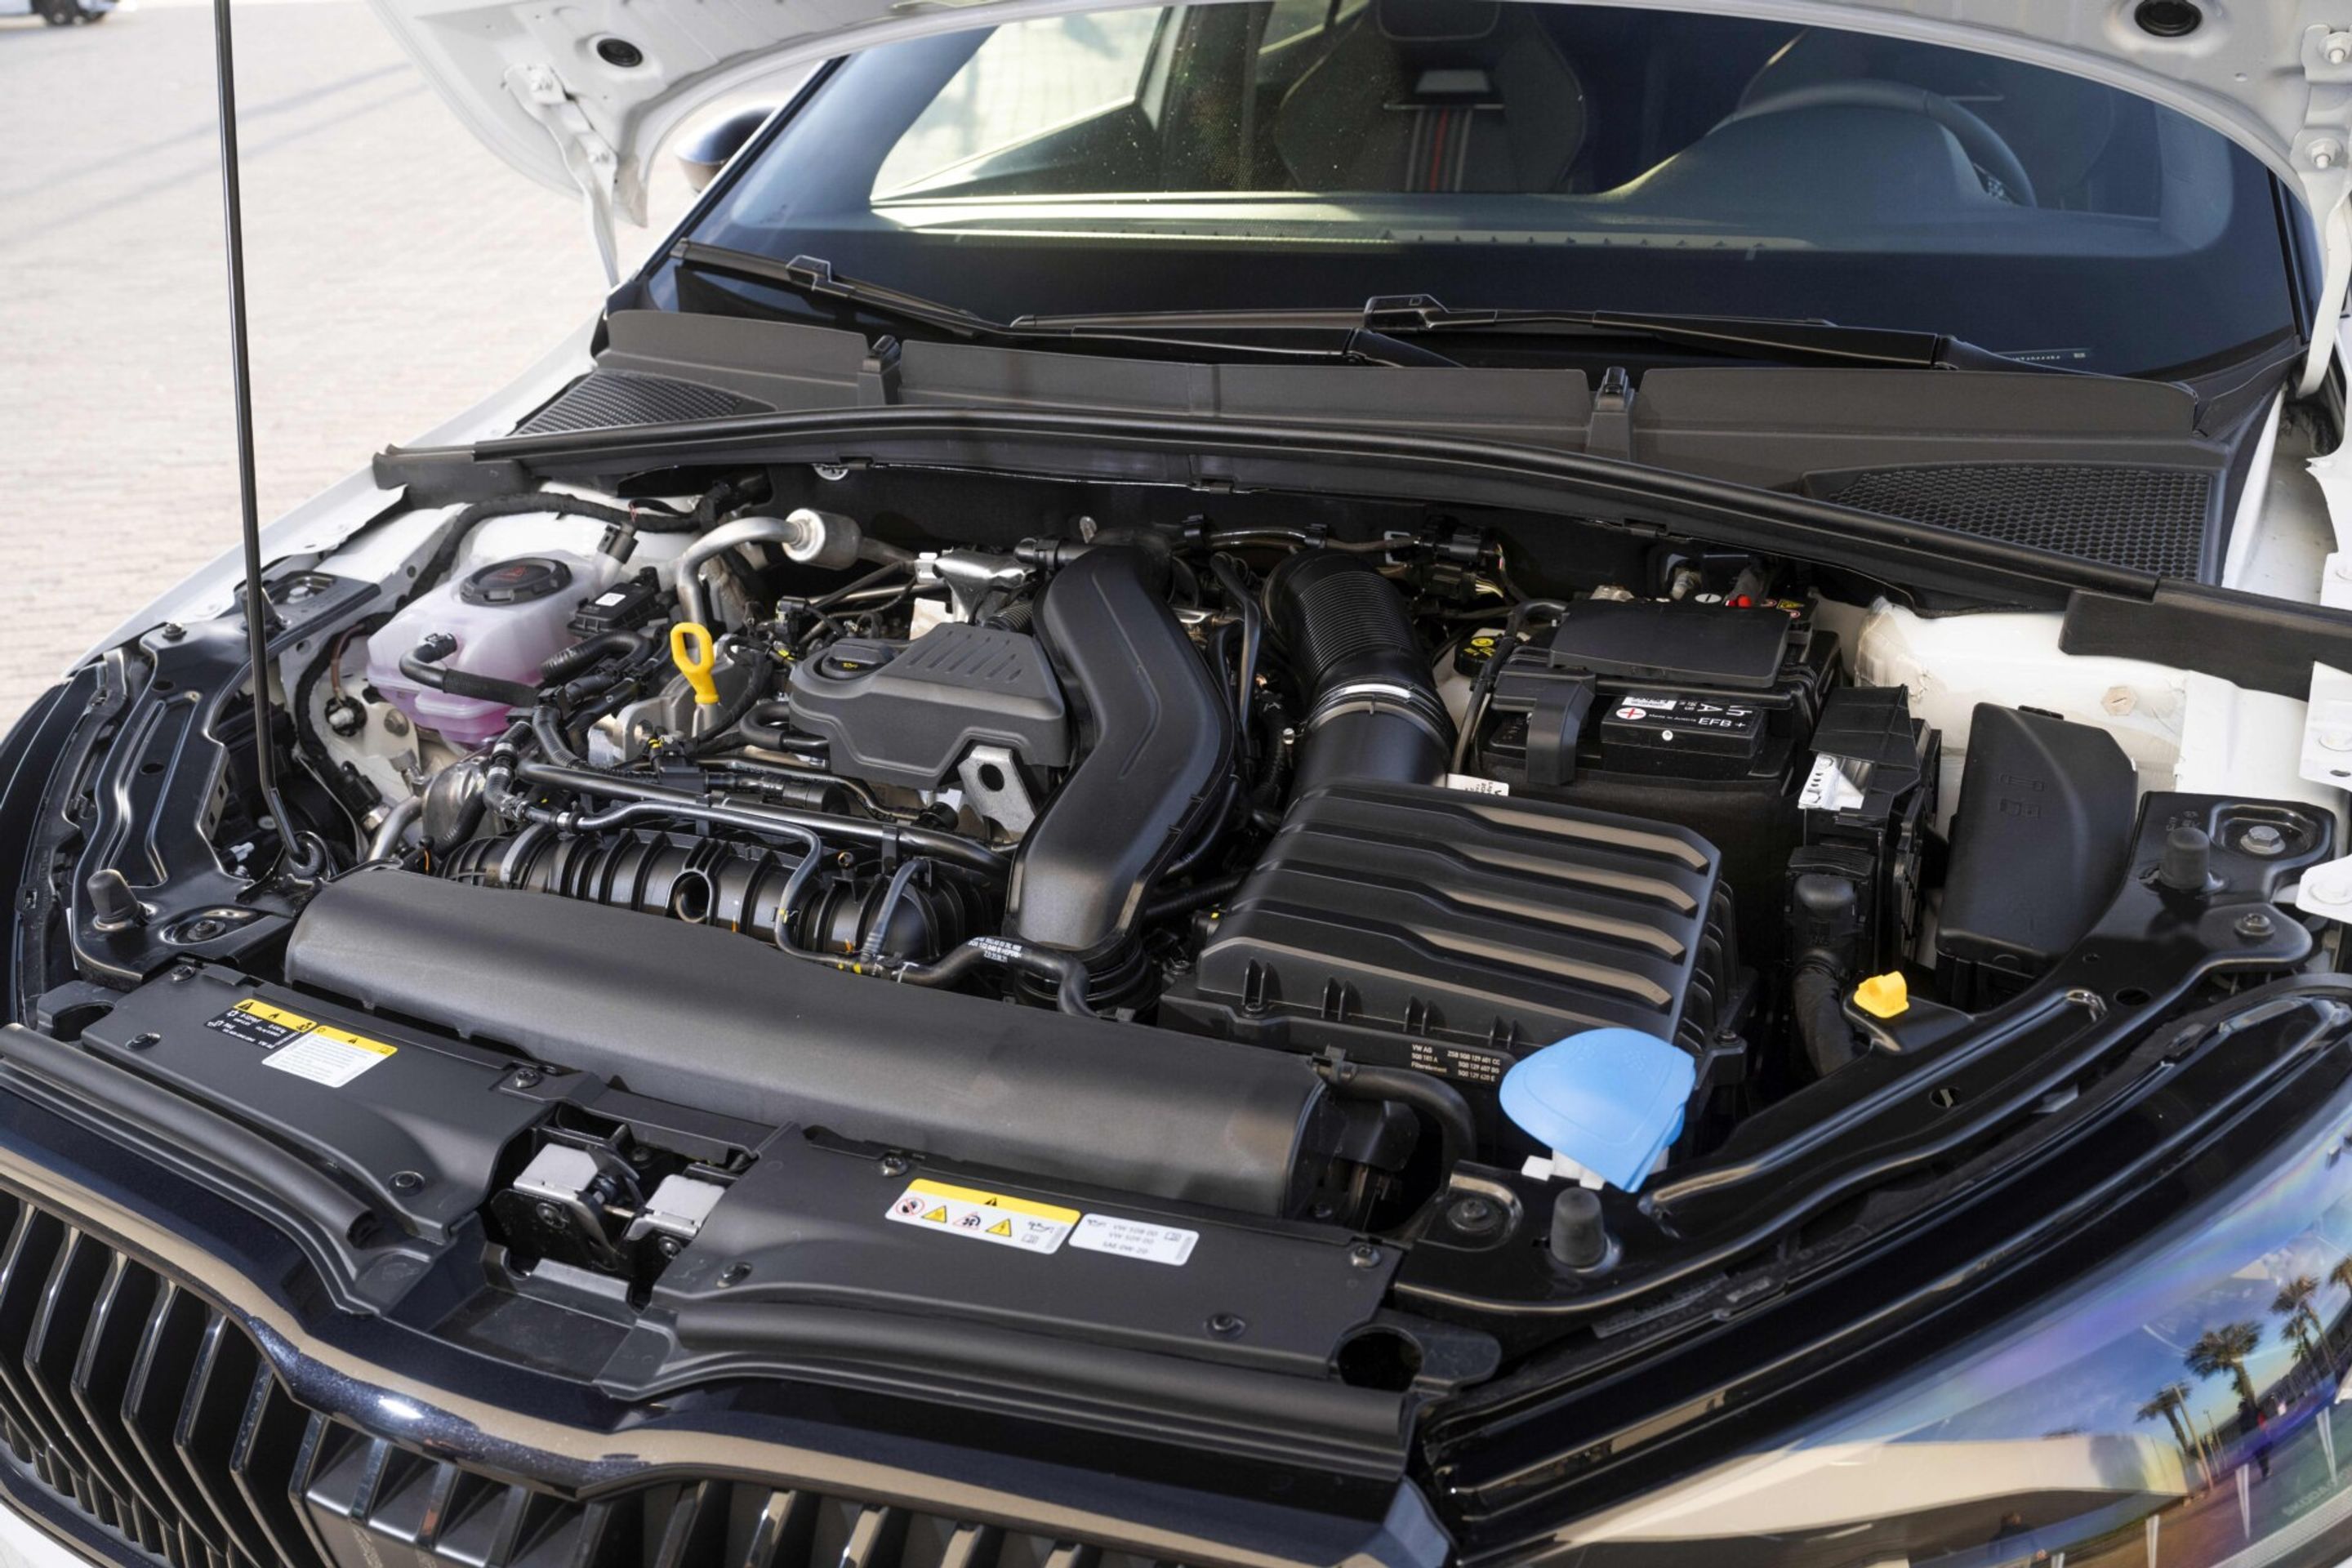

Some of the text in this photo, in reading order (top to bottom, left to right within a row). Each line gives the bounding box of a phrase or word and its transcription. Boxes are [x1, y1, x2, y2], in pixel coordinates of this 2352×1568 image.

[1699, 717, 1732, 728] EFB
[1412, 1044, 1422, 1053] VW
[1113, 1223, 1126, 1232] VW
[1109, 1232, 1123, 1240] VW
[1102, 1241, 1117, 1250] SAE
